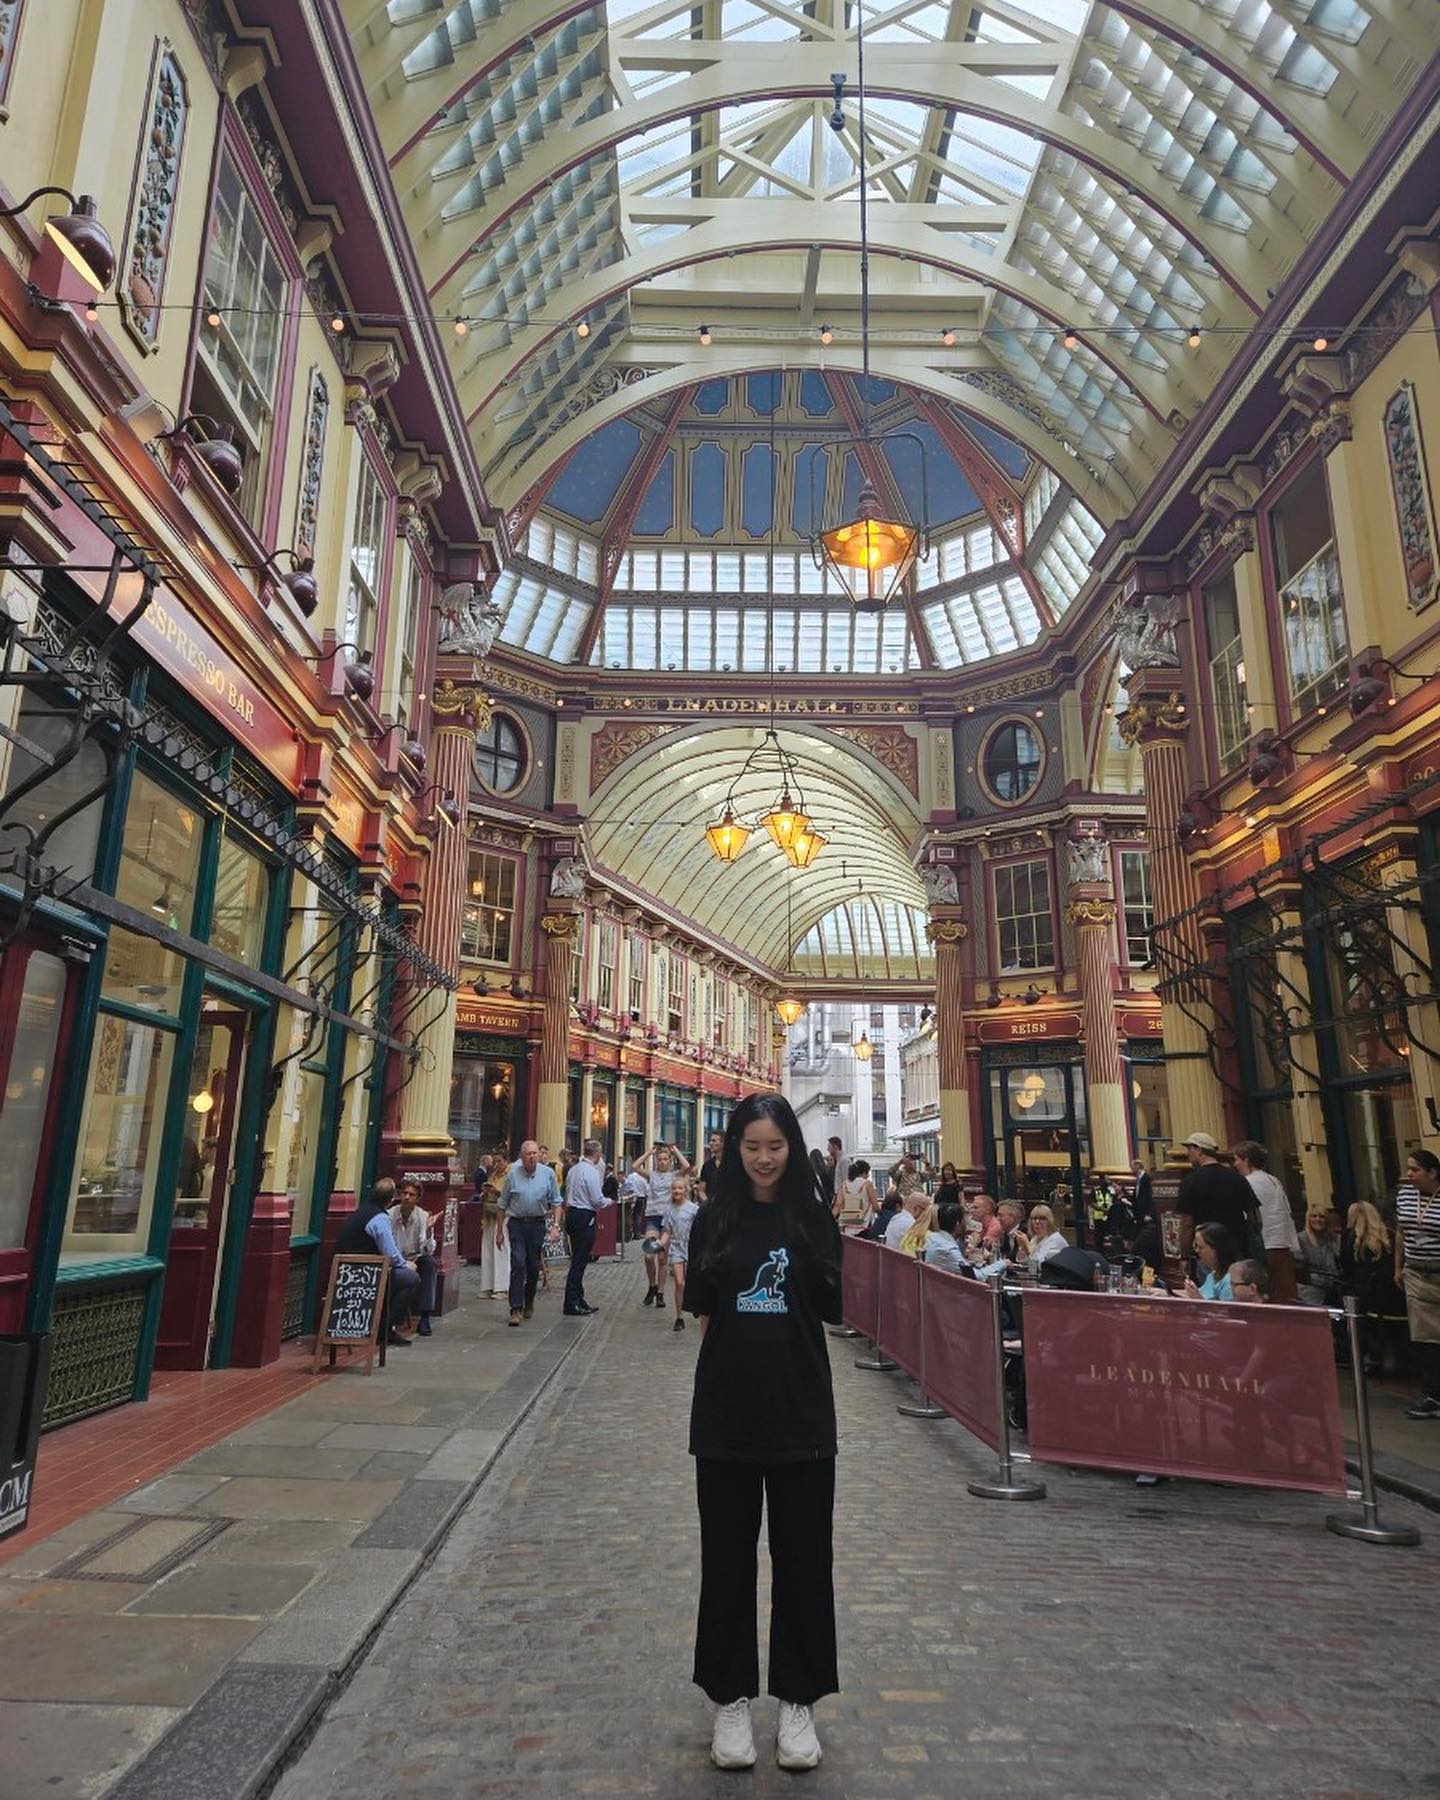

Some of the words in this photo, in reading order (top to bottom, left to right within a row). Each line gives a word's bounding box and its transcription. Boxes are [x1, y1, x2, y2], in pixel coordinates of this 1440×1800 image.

[145, 601, 225, 695] ESPRESSO
[228, 682, 254, 728] BAR
[666, 698, 847, 713] LEADENHALL
[456, 1012, 477, 1023] AMB
[480, 1015, 519, 1028] TAVERN
[1011, 1023, 1047, 1035] REISS
[336, 1264, 382, 1286] BEST
[336, 1287, 377, 1300] COFFEE
[1089, 1363, 1266, 1395] LEADENHALL
